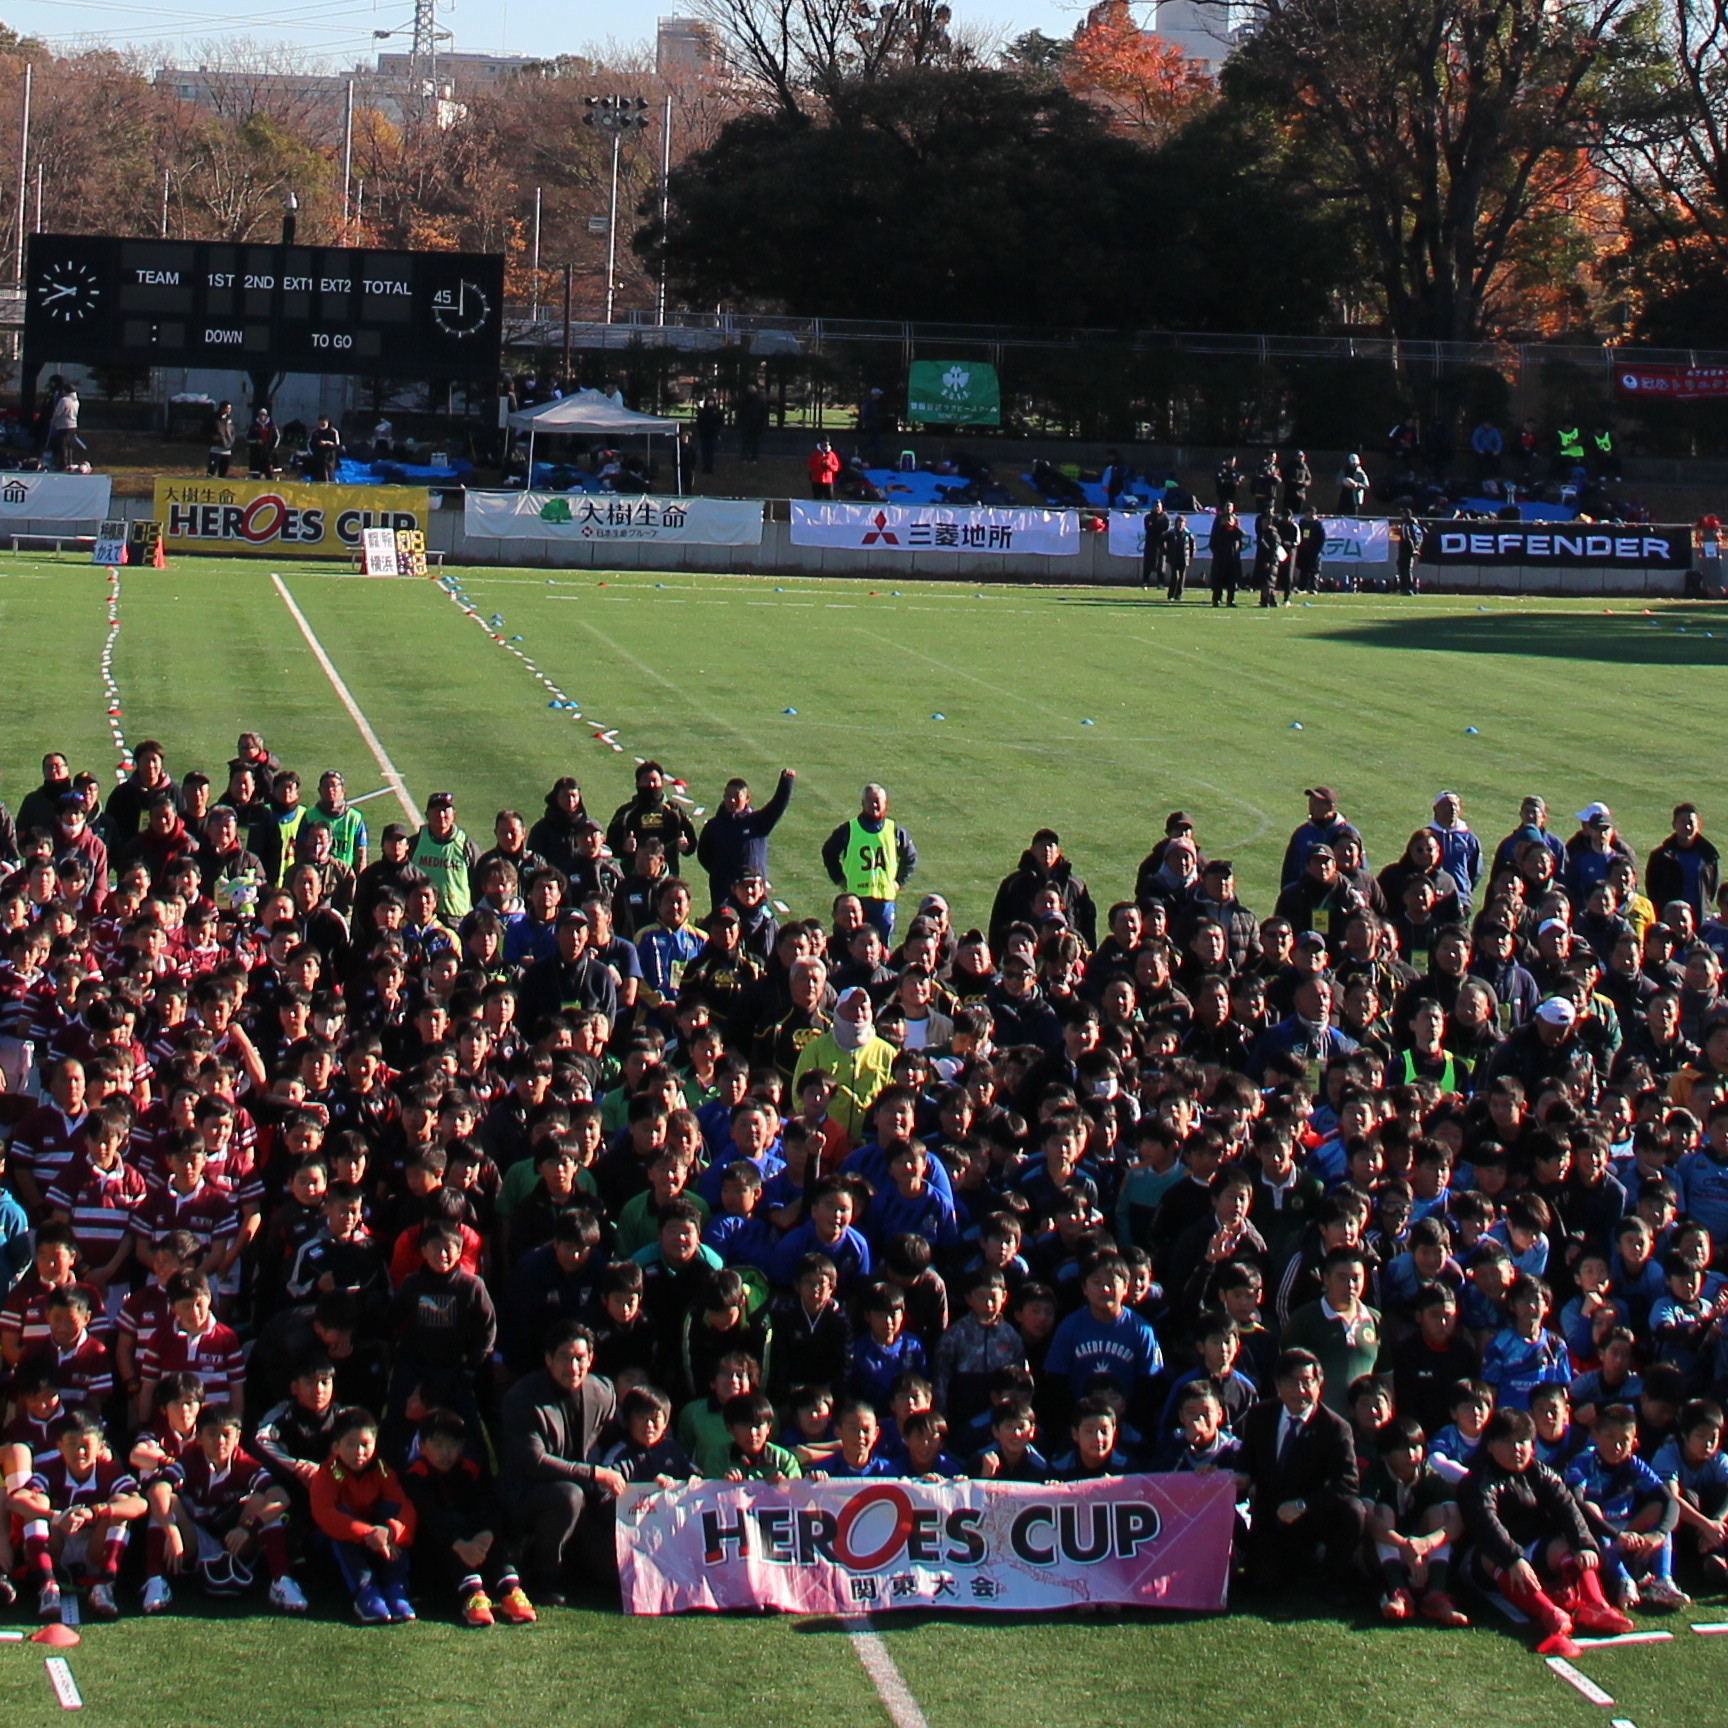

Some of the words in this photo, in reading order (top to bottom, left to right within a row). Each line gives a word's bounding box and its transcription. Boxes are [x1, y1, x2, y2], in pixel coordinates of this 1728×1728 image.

[136, 269, 180, 285] TEAM
[207, 273, 235, 288] 1ST
[244, 274, 275, 290] 2ND
[283, 276, 313, 291] EXT1
[320, 278, 352, 293] EXT2
[363, 280, 413, 296] TOTAL
[433, 289, 452, 304] 45
[204, 329, 243, 344] DOWN
[312, 333, 329, 348] TO
[333, 334, 353, 349] GO
[164, 486, 237, 504] 大樹生命
[168, 492, 325, 545] HEROES
[580, 502, 688, 529] 大樹生命
[908, 522, 1013, 550] 三菱地所
[1440, 532, 1671, 560] DEFENDER
[859, 845, 887, 871] SA
[1074, 1340, 1104, 1359] KAEDE
[703, 1485, 989, 1572] HEROES
[1010, 1501, 1163, 1566] CUP
[851, 1575, 1000, 1602] 関東大会
